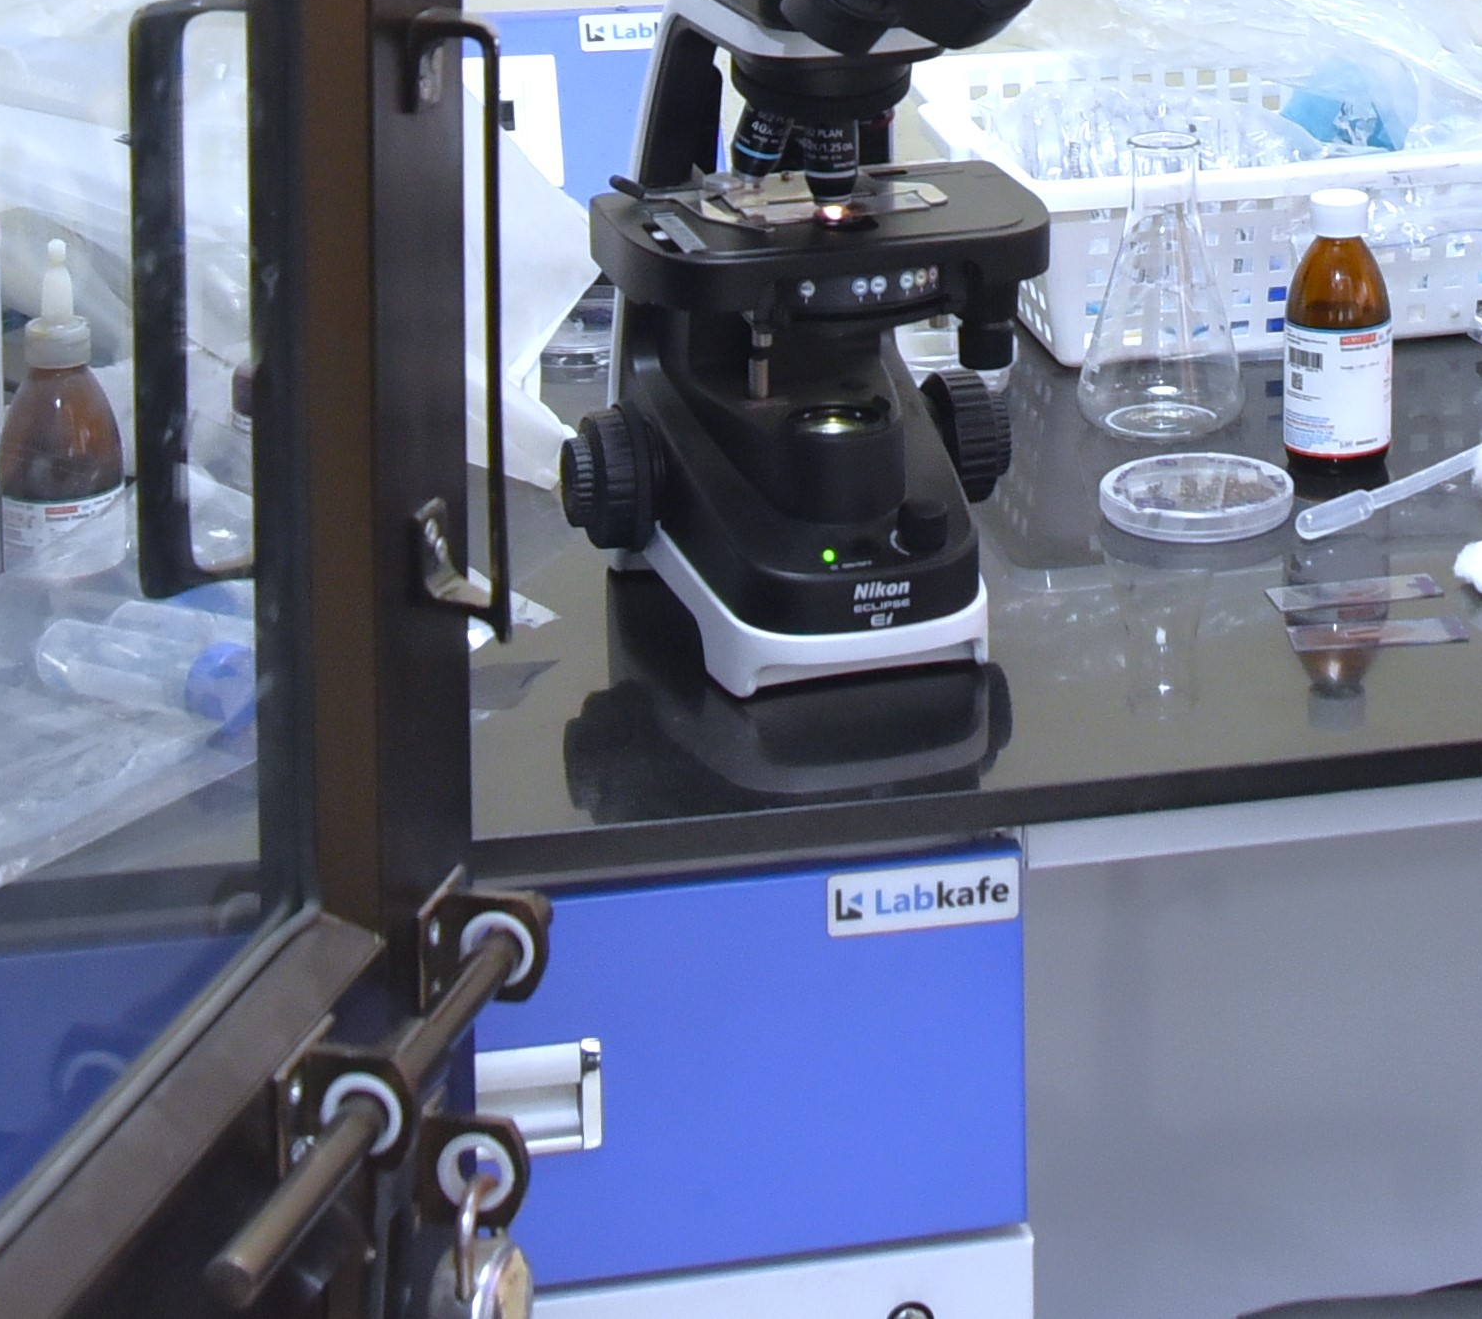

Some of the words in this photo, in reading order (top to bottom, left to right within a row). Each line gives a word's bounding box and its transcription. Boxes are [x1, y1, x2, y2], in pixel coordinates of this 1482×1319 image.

[853, 580, 911, 601] Nikon
[853, 597, 911, 614] ECLIPSE
[874, 876, 1010, 916] Labkafe
